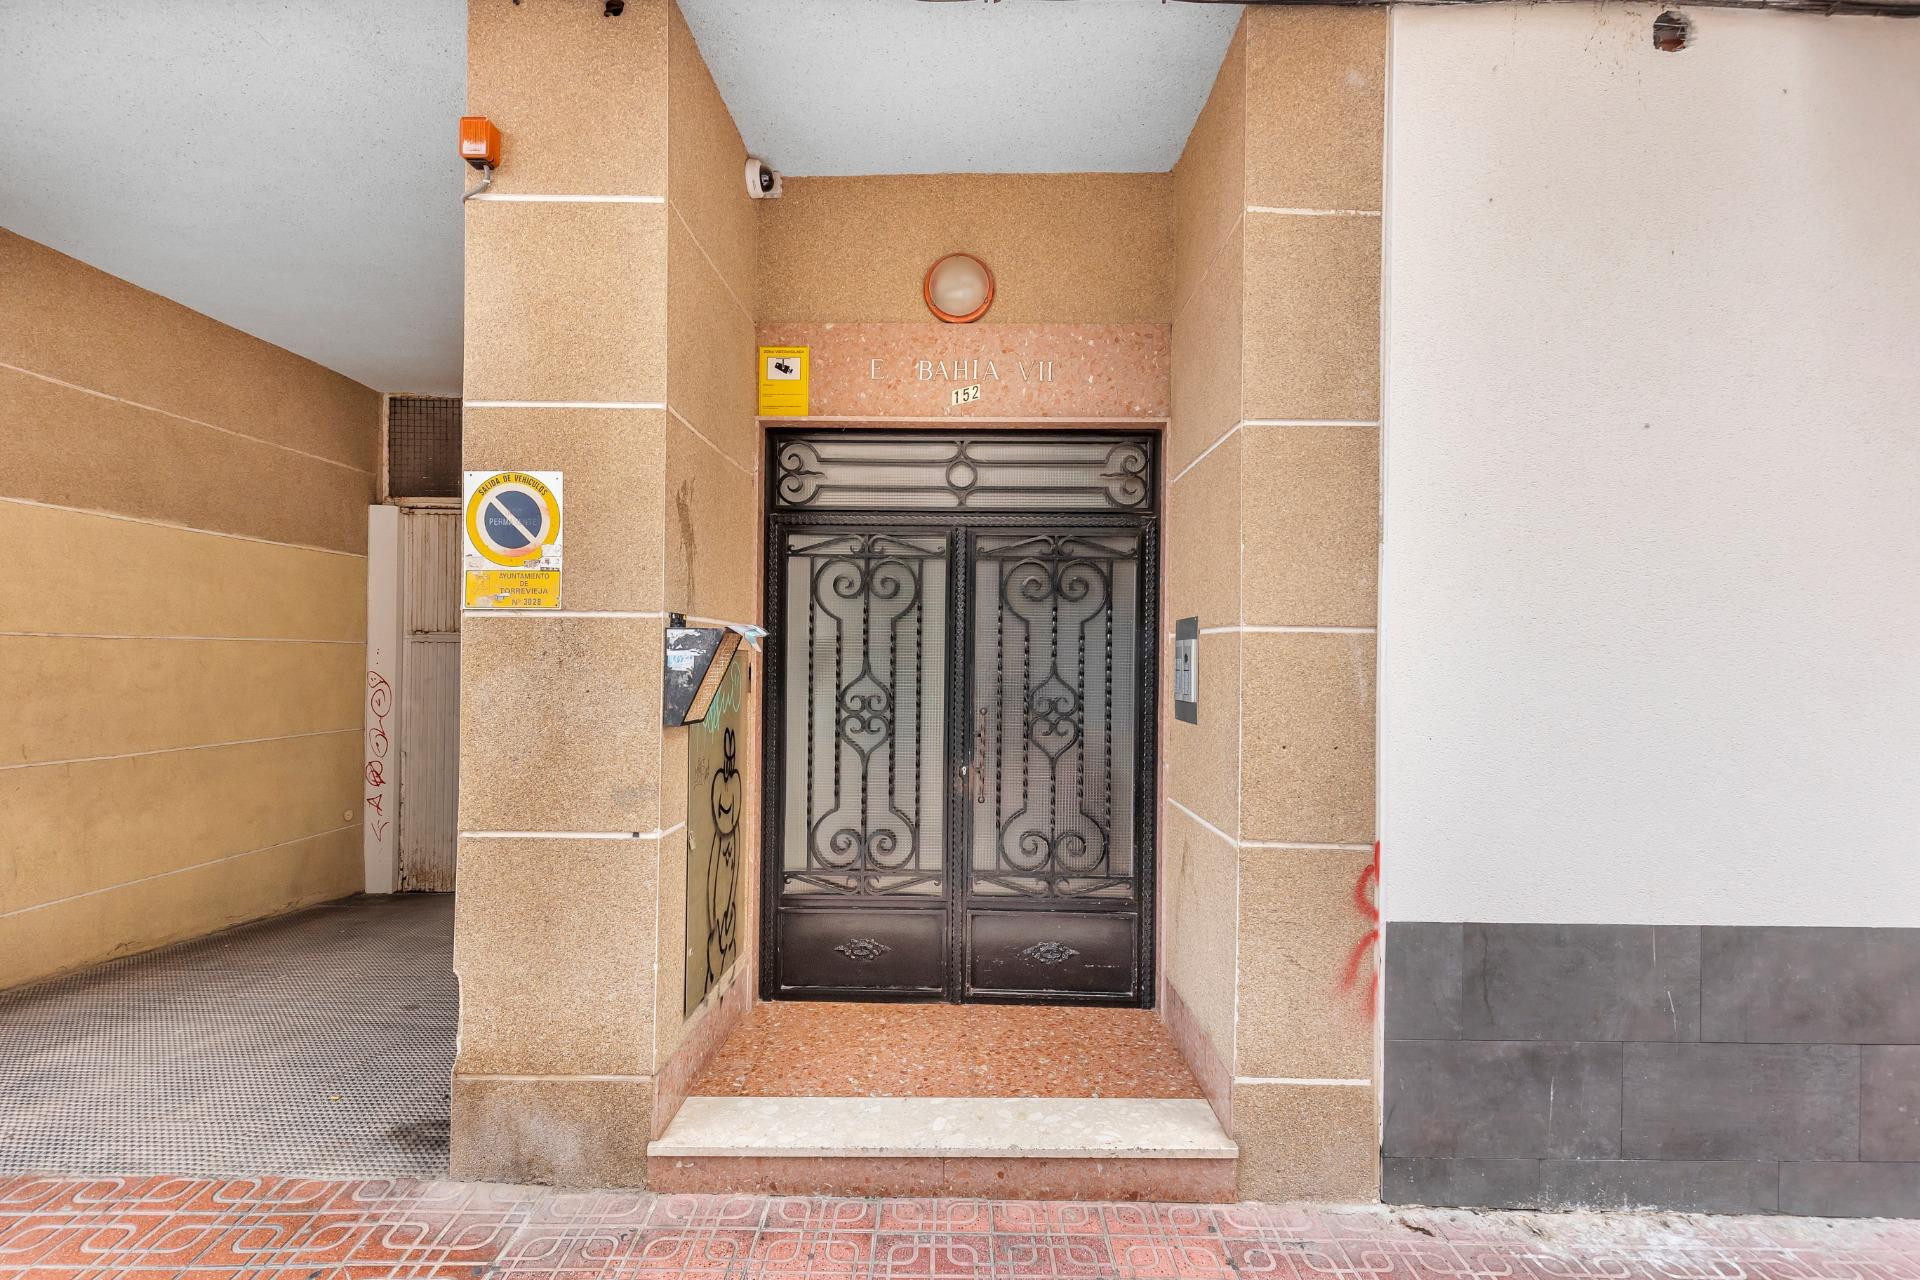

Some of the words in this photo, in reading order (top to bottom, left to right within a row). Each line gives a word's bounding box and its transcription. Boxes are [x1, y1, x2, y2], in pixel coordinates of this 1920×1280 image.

[918, 359, 999, 381] BAHIA
[1018, 360, 1054, 382] VII
[954, 385, 979, 404] 152
[478, 476, 501, 496] SALIDA
[503, 474, 511, 482] DE
[514, 474, 548, 496] VEHICULOS
[499, 572, 550, 580] AYUNTAMIENTO
